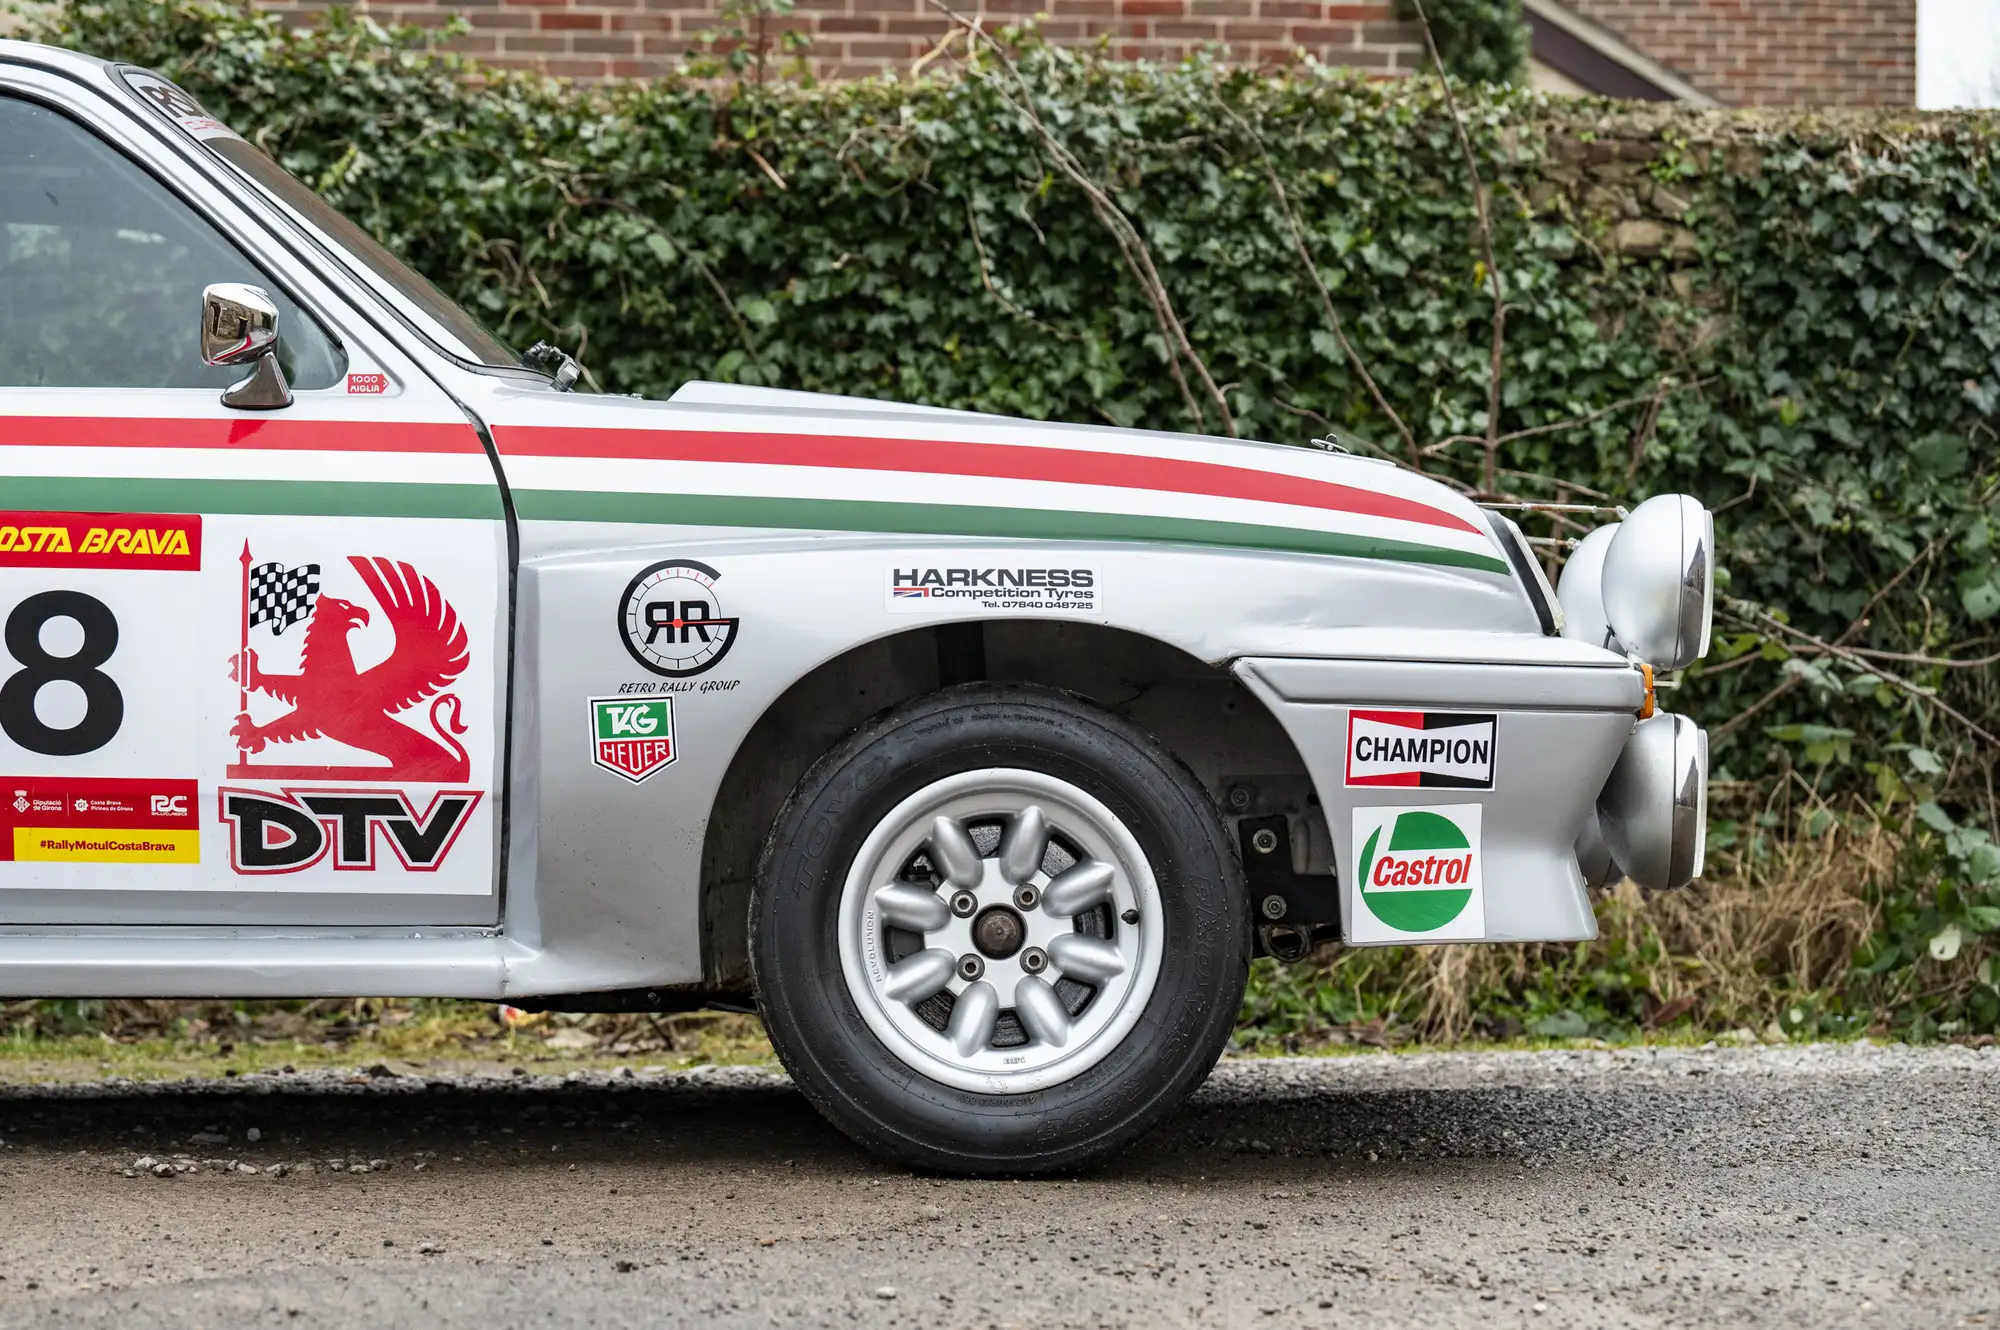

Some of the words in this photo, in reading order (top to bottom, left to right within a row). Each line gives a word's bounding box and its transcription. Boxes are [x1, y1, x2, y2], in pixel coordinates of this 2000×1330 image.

[78, 528, 190, 555] BRAVA
[893, 568, 1094, 587] HARKNESS
[931, 587, 1040, 600] Competition
[1044, 588, 1094, 601] Tyres
[0, 590, 124, 756] 8
[618, 682, 656, 694] RETRO
[660, 681, 697, 693] RALLY
[700, 680, 740, 694] GROUP
[606, 704, 658, 734] TAG
[603, 742, 667, 773] HEUER
[1355, 736, 1488, 764] CHAMPION
[33, 798, 62, 806] Diputació
[218, 786, 485, 875] DTV
[792, 756, 890, 899] TOYO
[40, 840, 176, 851] #RallyMotulCostaBrava
[1373, 854, 1473, 886] Castrol
[866, 910, 882, 982] REVOLUTION
